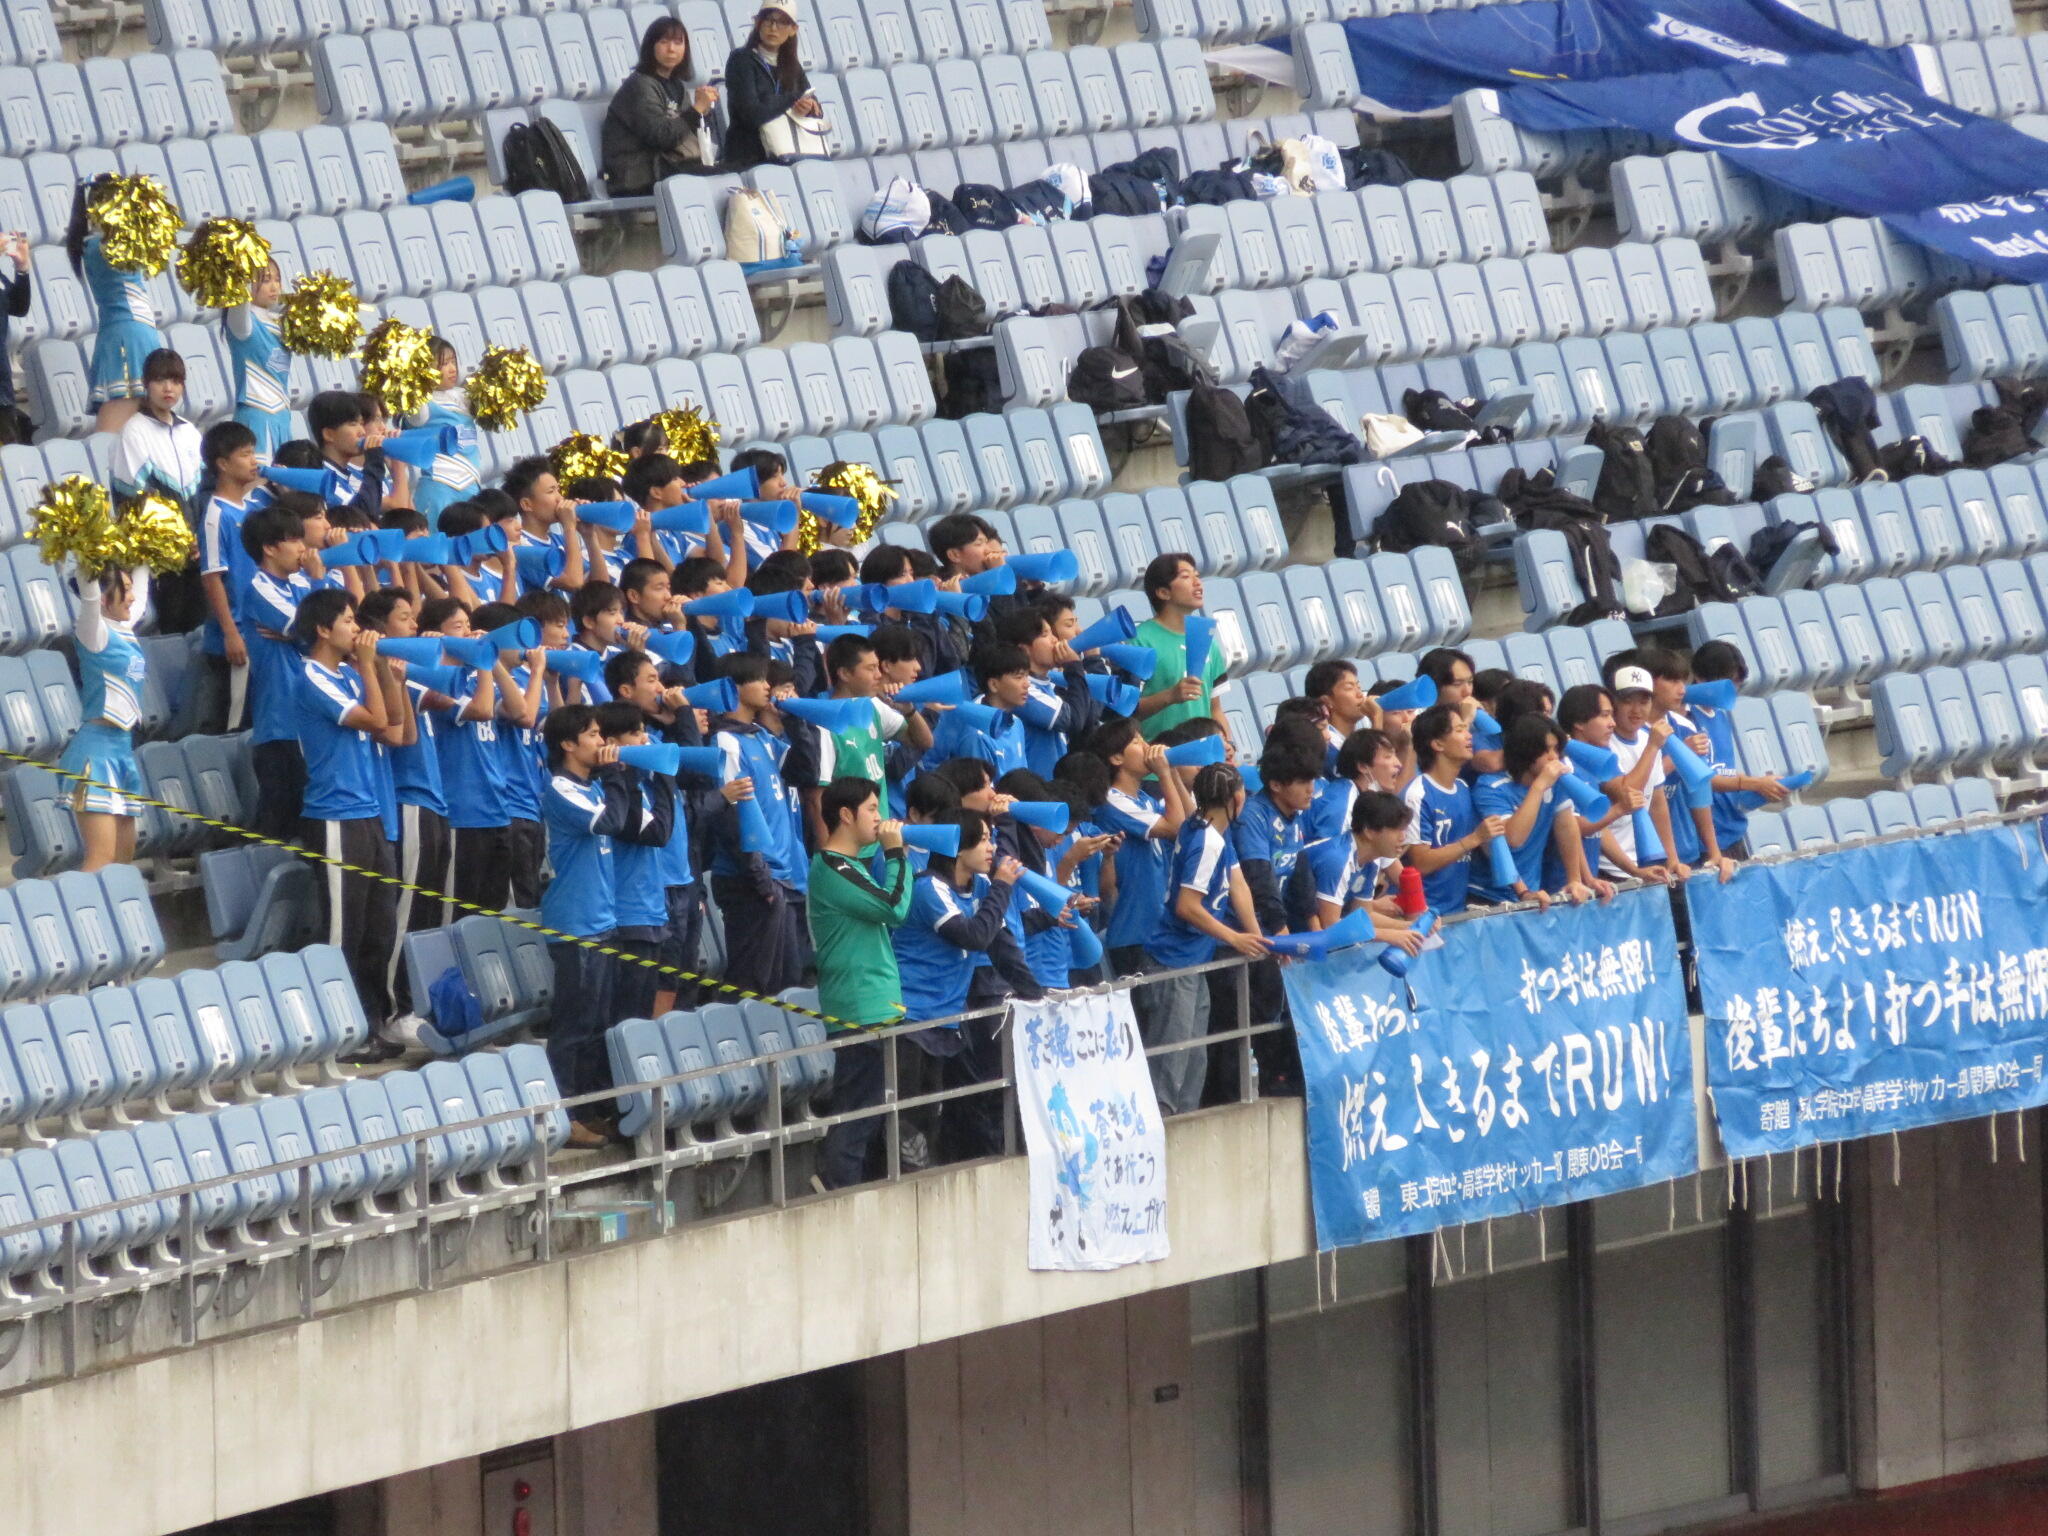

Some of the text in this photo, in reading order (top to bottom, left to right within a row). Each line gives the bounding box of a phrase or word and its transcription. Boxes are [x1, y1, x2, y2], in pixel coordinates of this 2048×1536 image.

[1436, 818, 1452, 845] 77
[1784, 889, 1983, 971] 燃え尽きるまでRUN
[1520, 938, 1656, 1015] 打つ手は無限!
[1760, 1098, 1790, 1132] 寄贈
